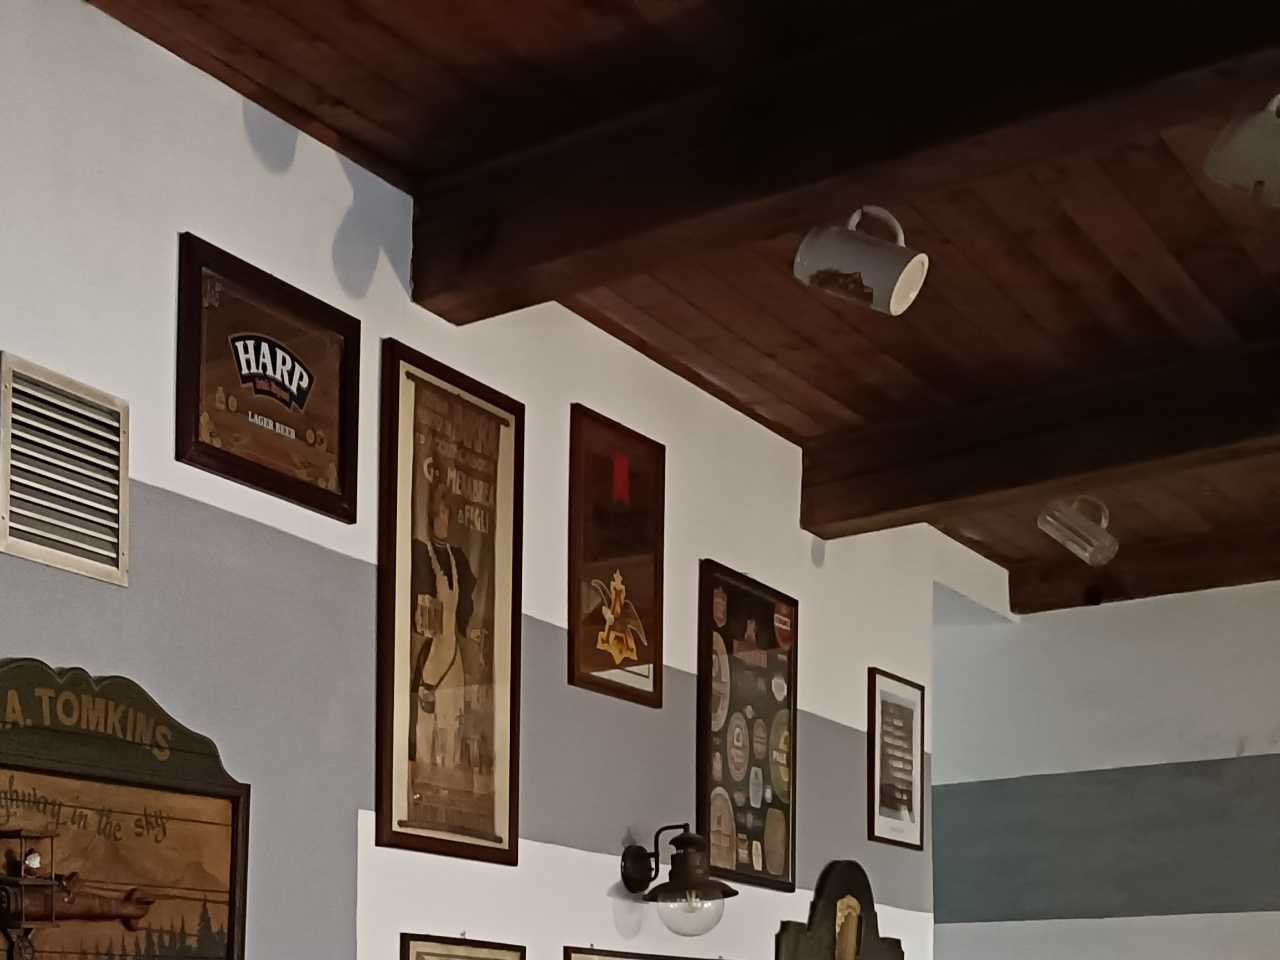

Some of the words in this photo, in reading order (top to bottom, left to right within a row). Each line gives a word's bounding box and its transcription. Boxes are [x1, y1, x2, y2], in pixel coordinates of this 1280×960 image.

[234, 340, 309, 394] HARP
[248, 410, 274, 431] LAGER
[34, 686, 173, 761] TOMKINS
[70, 795, 89, 829] in
[94, 805, 123, 841] the
